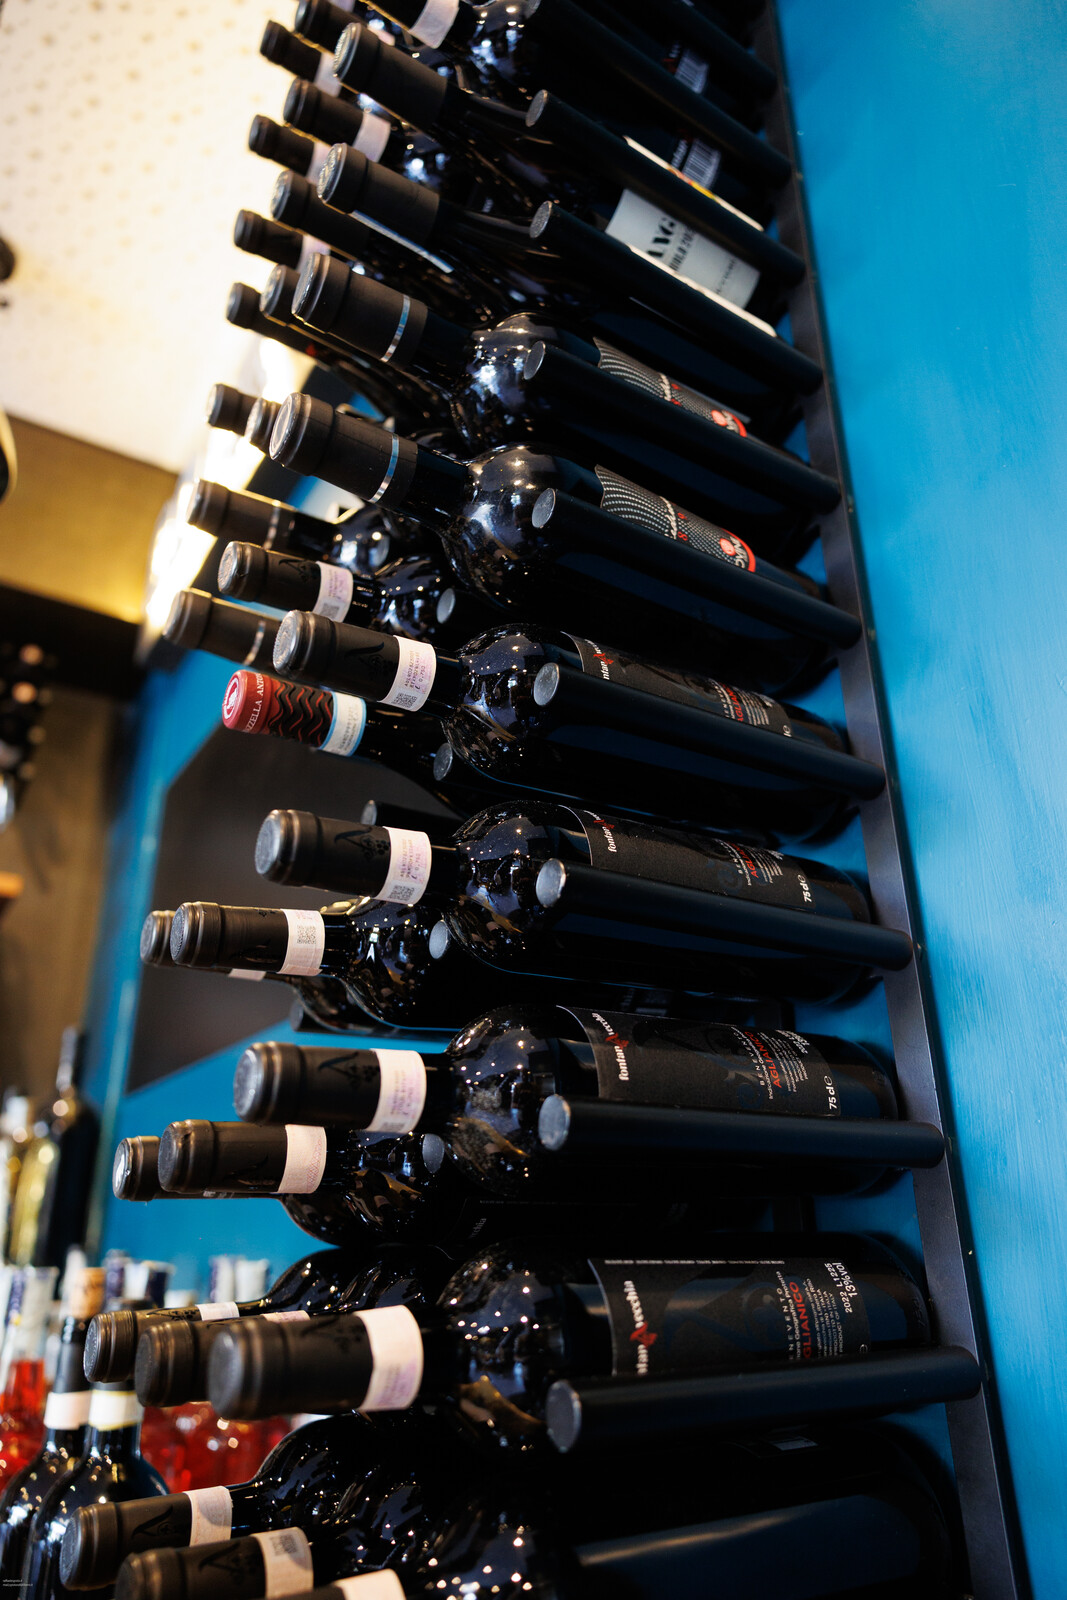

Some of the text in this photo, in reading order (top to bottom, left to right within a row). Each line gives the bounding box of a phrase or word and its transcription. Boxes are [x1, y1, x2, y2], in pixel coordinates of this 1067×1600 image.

[256, 673, 264, 696] ANTO
[745, 1032, 782, 1088] AGLIANICO
[828, 1097, 838, 1110] 75
[840, 1292, 853, 1314] 2022
[789, 1281, 813, 1360] GLIANICO
